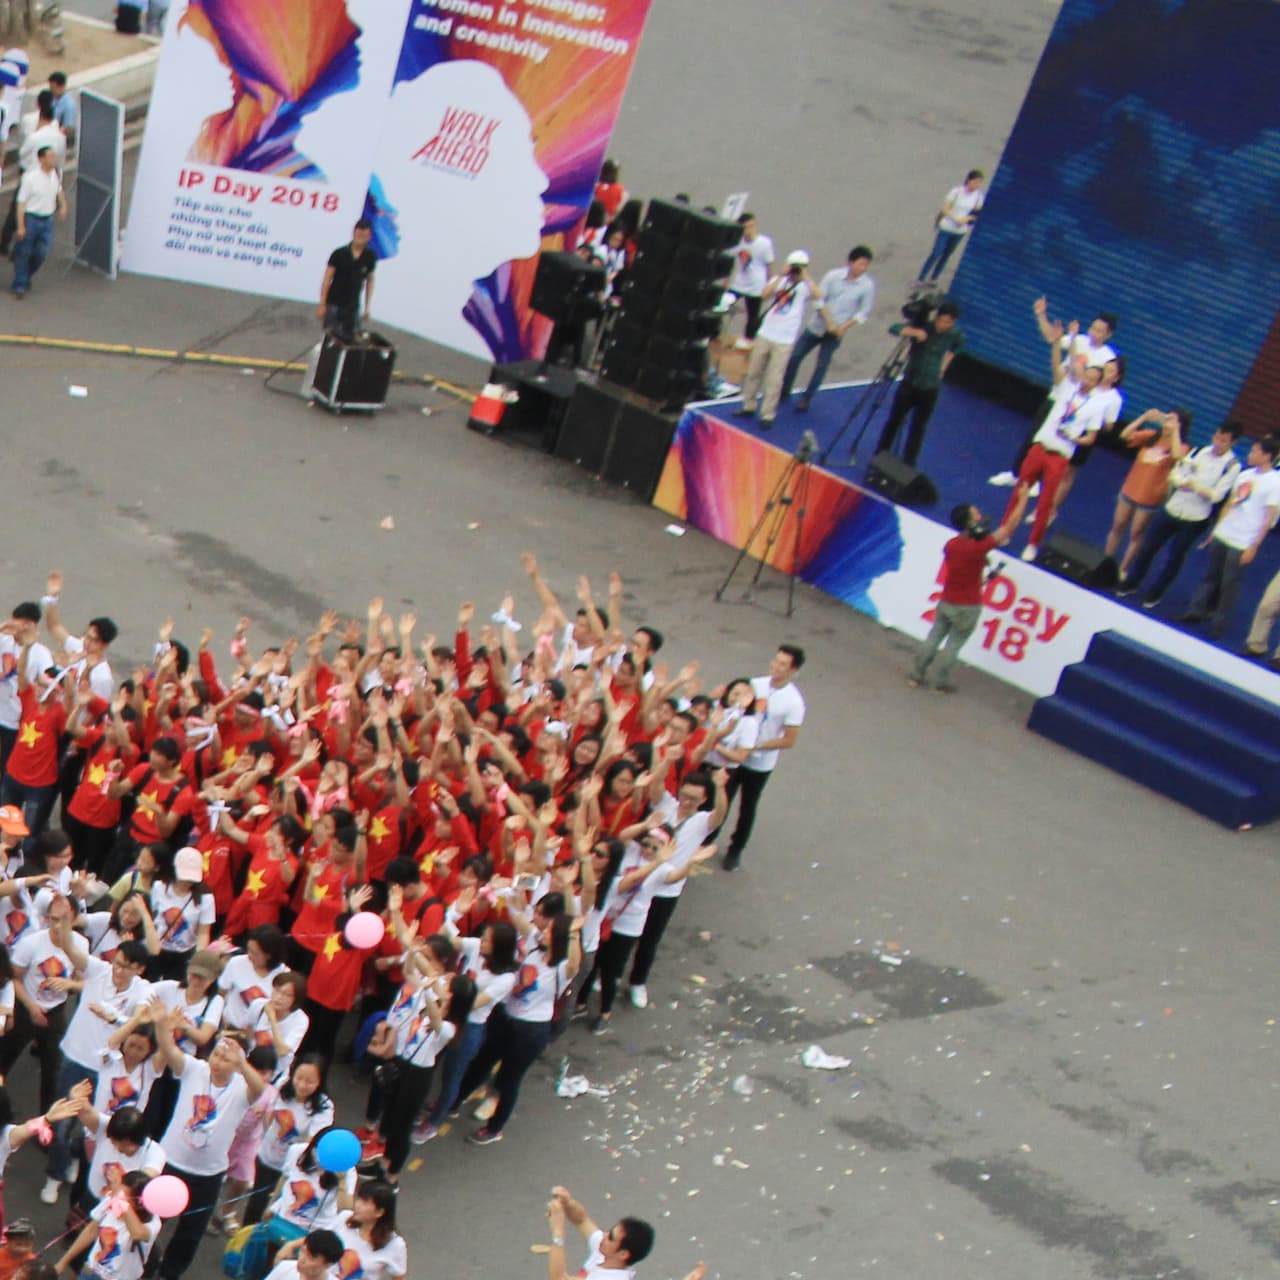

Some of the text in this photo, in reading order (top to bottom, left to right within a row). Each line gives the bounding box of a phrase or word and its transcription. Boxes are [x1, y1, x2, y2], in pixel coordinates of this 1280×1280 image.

[413, 13, 551, 64] and creativity
[521, 10, 629, 55] innovation
[439, 105, 502, 145] WALK
[178, 169, 339, 212] IP Day 2018
[983, 574, 1070, 643] Day
